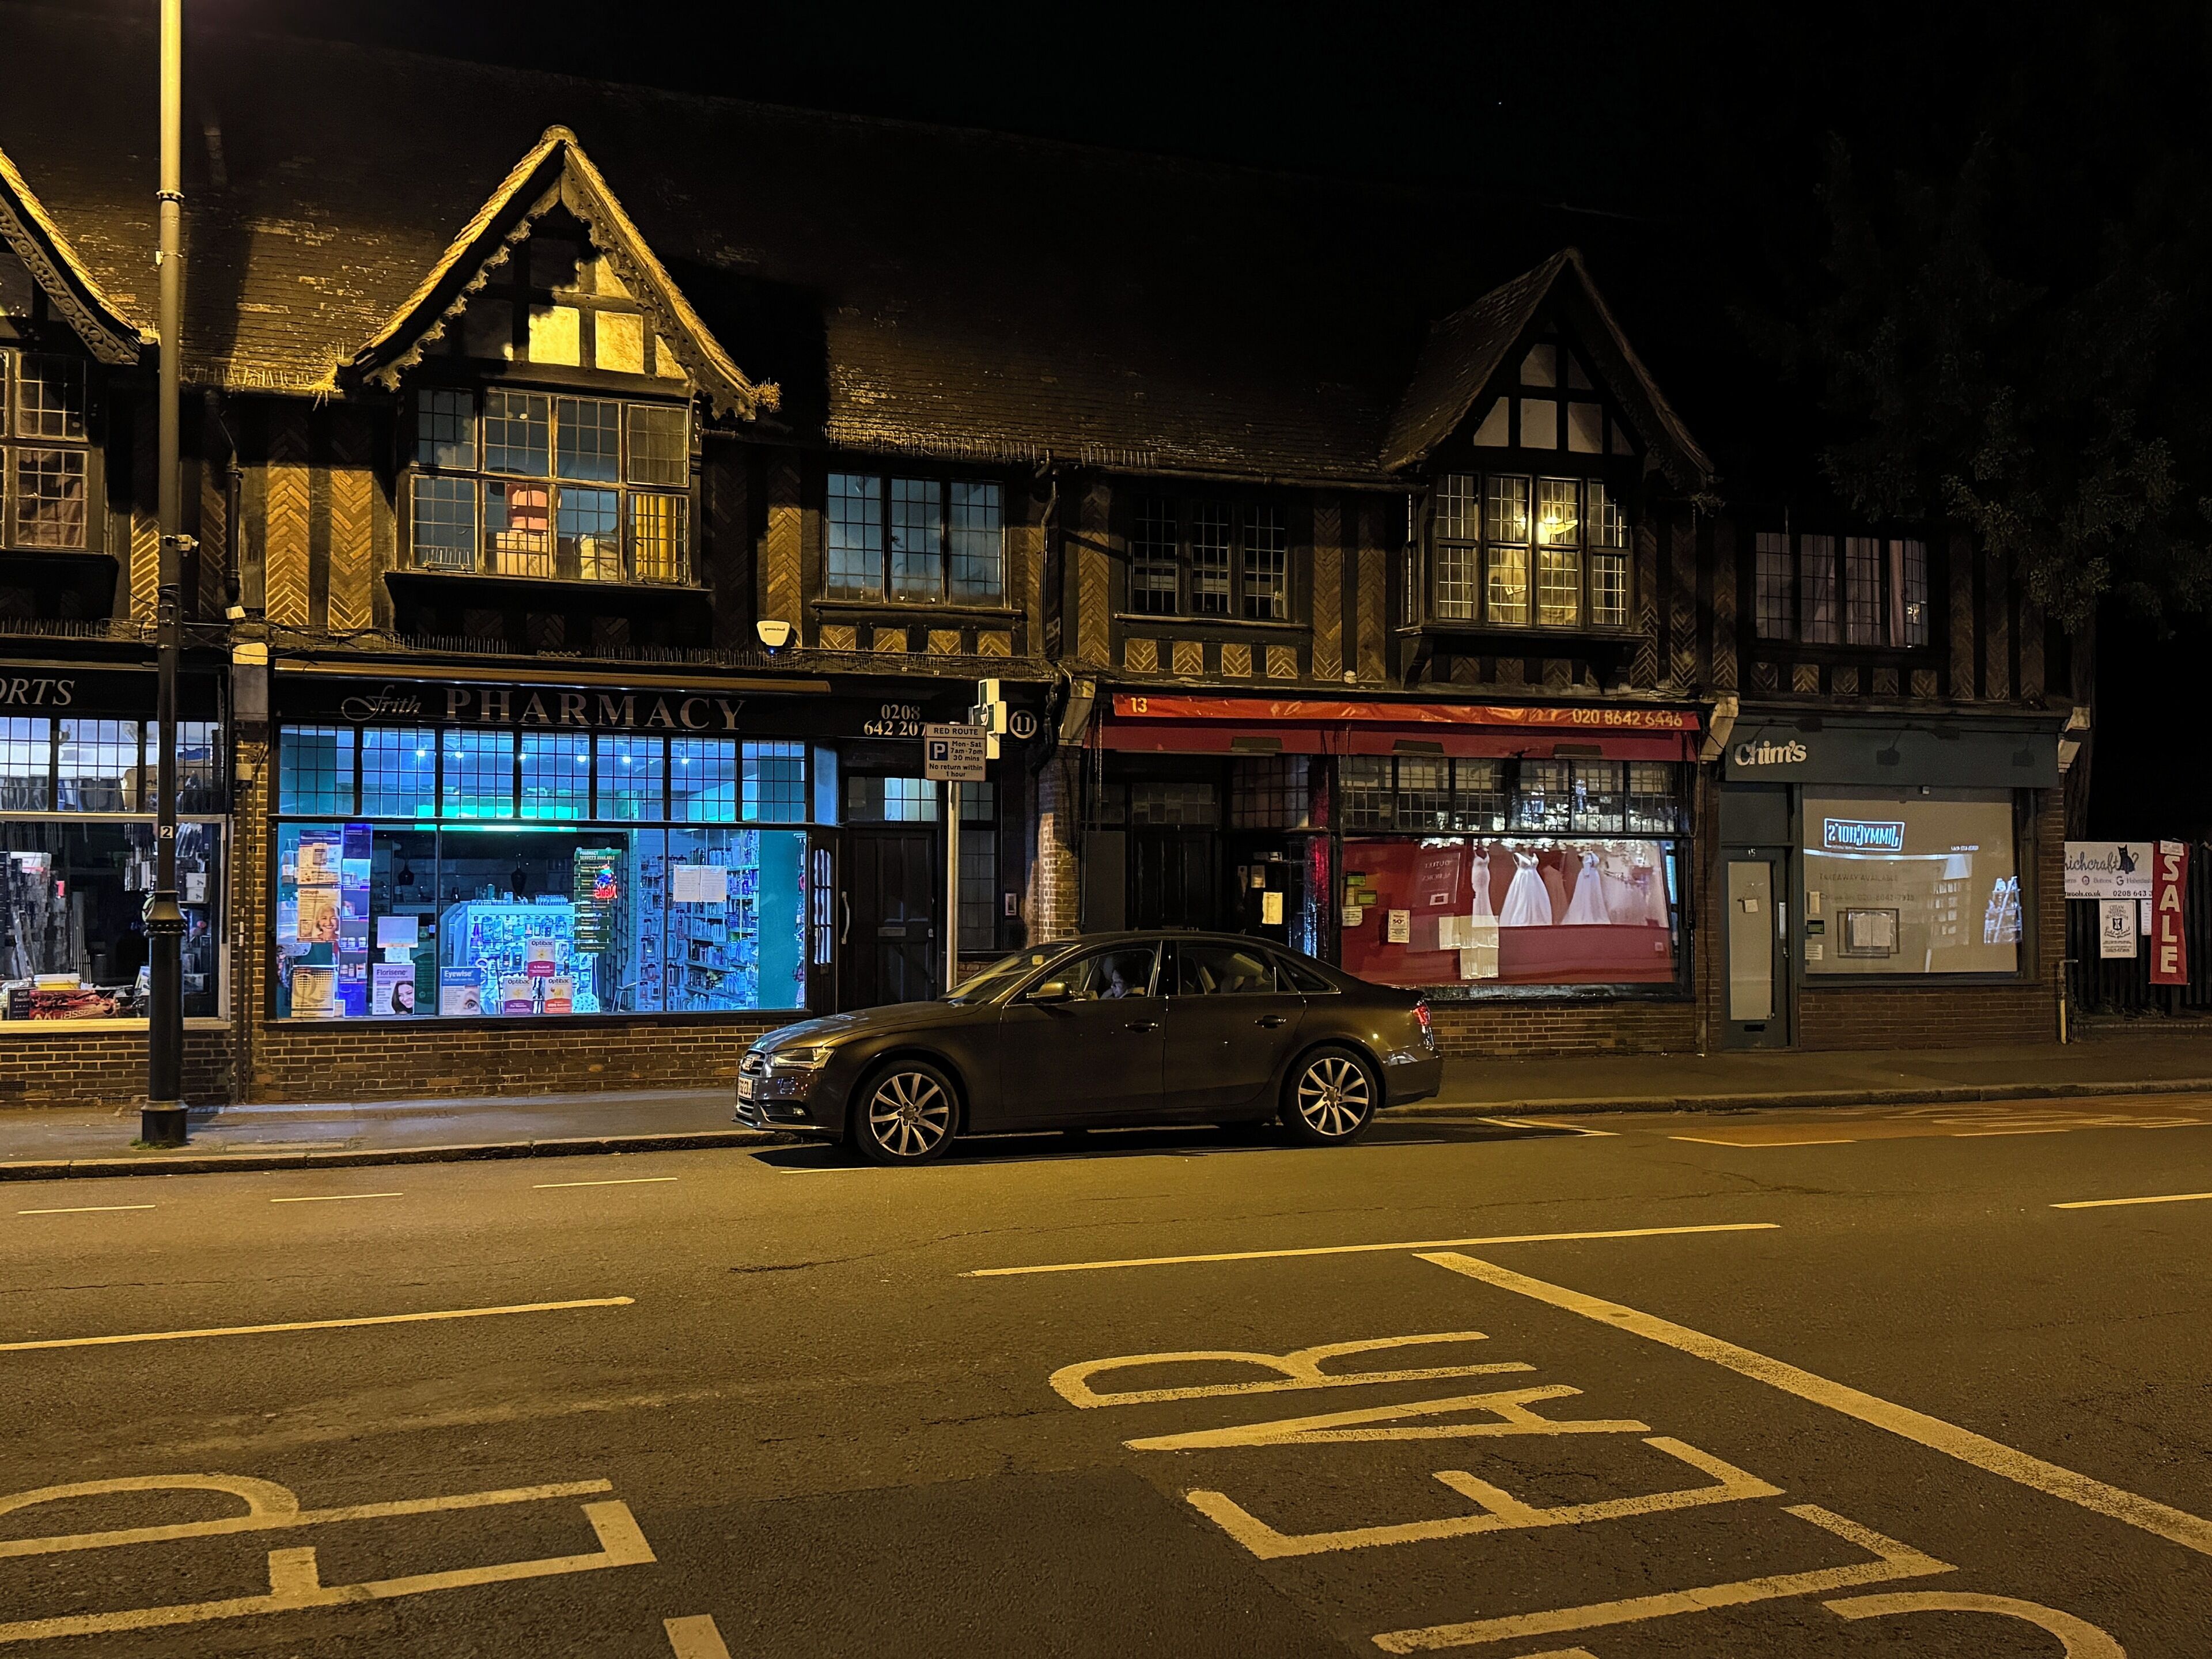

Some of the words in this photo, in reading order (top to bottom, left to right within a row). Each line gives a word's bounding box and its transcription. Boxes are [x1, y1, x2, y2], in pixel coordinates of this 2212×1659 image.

[341, 684, 422, 721] Frith
[444, 687, 747, 731] PHARMACY
[881, 704, 921, 719] 0208
[1131, 697, 1147, 713] 13
[1017, 716, 1031, 732] 11
[1573, 708, 1600, 724] 020
[1604, 709, 1641, 726] 8642
[864, 719, 893, 736] 642
[934, 743, 946, 759] P
[1734, 740, 1806, 766] Chim's
[162, 827, 171, 837] 2
[2159, 855, 2180, 974] SALE
[444, 970, 472, 978] Eyewise
